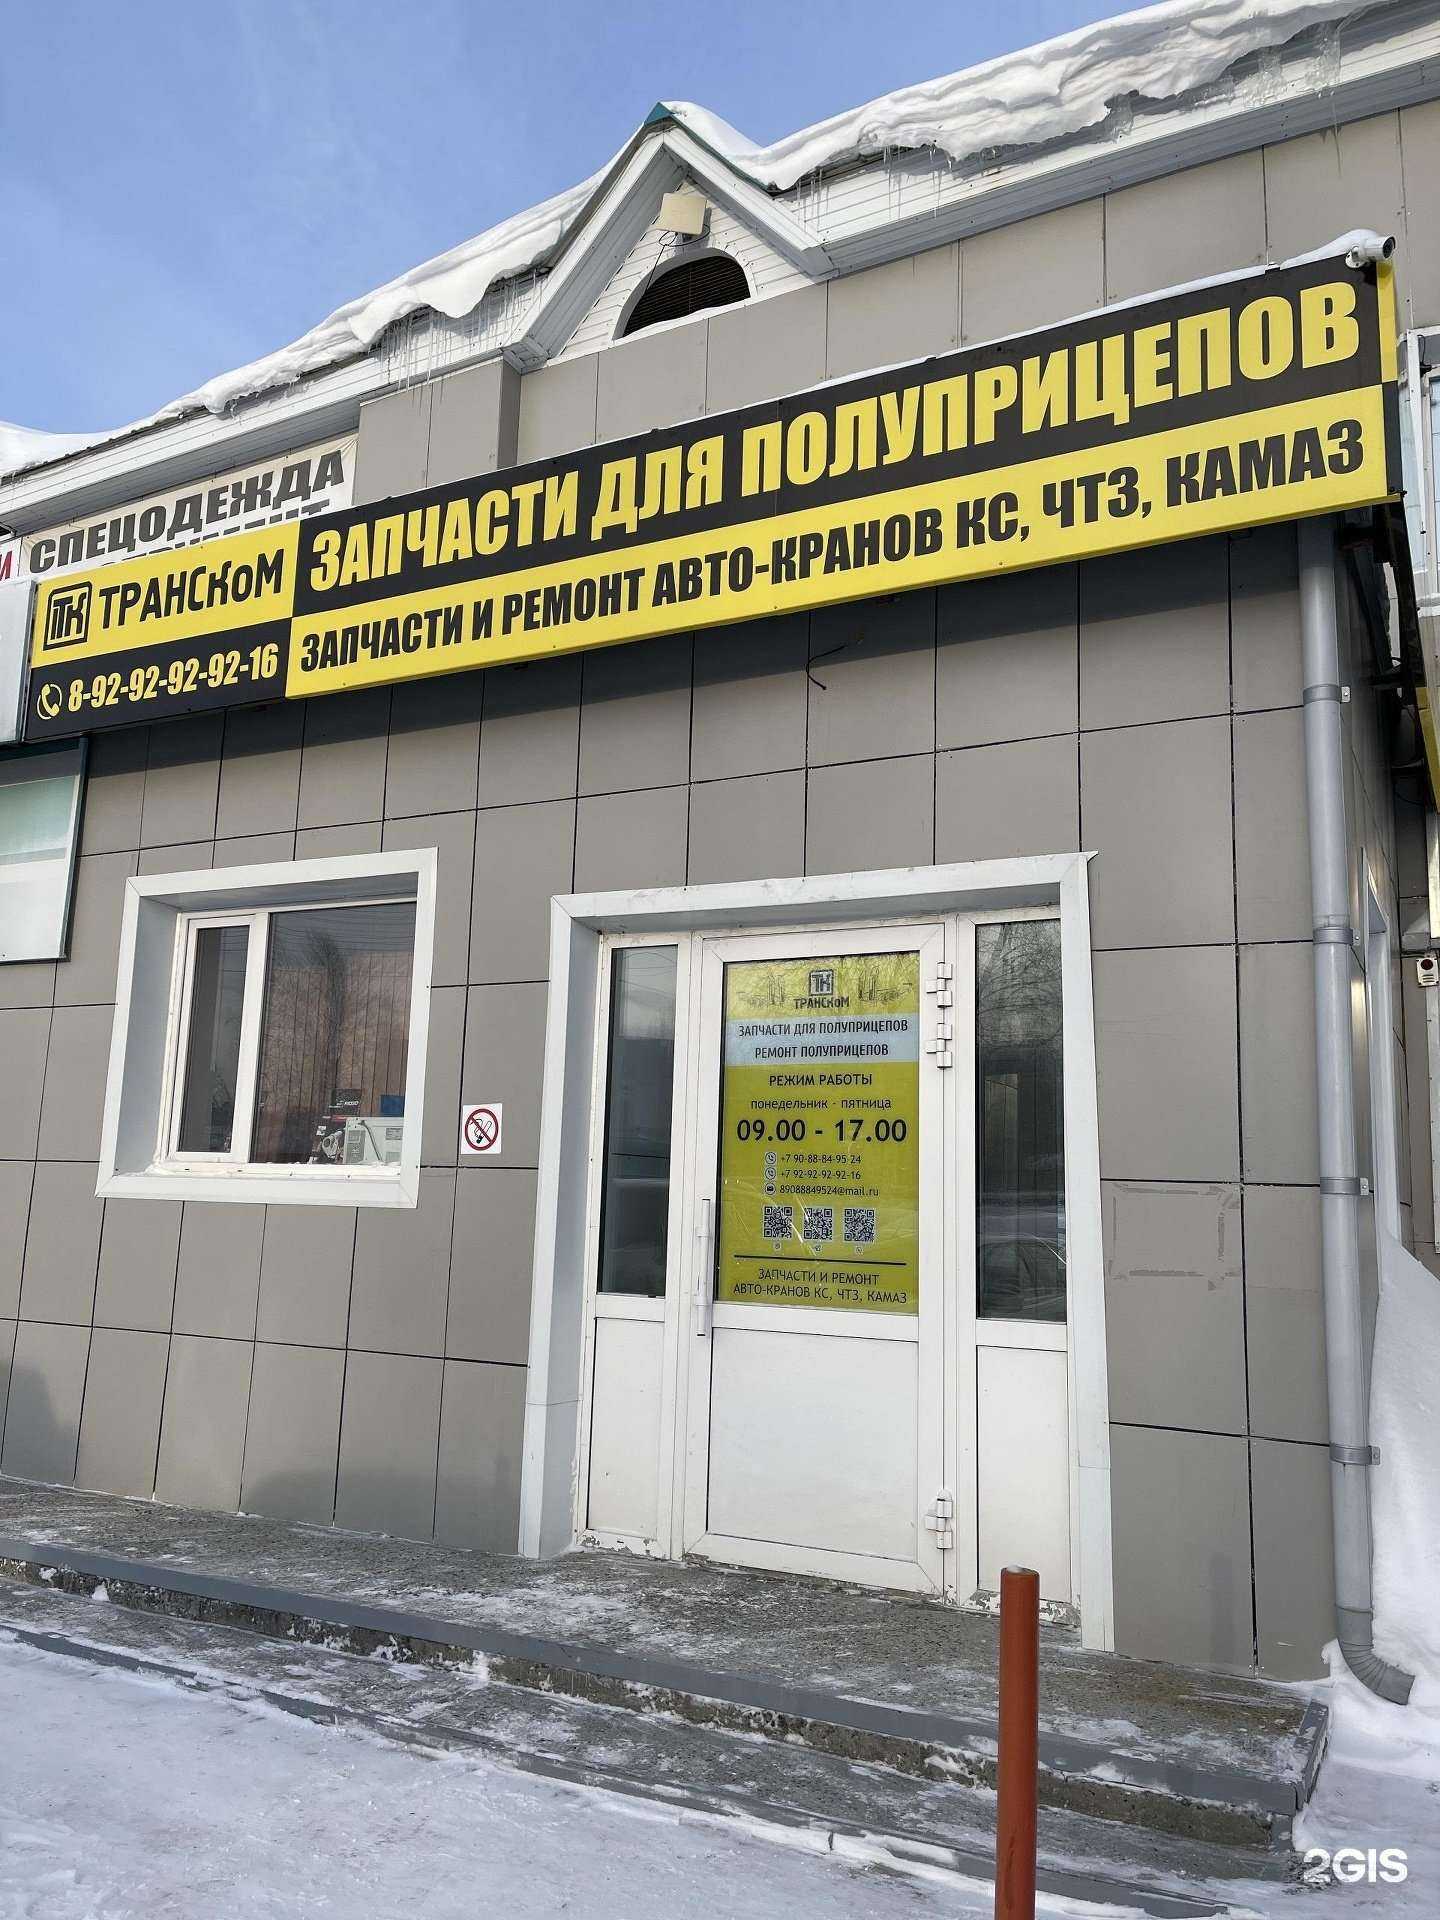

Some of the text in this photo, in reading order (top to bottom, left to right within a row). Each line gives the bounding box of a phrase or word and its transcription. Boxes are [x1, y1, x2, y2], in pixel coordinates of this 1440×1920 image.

[310, 471, 579, 592] ЗАПЧАСТИ
[591, 436, 724, 541] ДЛЯ
[741, 281, 1360, 497] ПОЛУПРИЦЕПОВ
[29, 450, 345, 574] СПЕЦОДЕЖДА
[300, 605, 462, 673] ЗАПЧАСТИ
[472, 598, 493, 640] И
[502, 568, 645, 634] РЕМОНТ
[652, 507, 943, 607] АВТО-КРАНОВ
[956, 491, 1030, 549] КС,
[1166, 419, 1364, 507] КАМАЗ
[67, 642, 278, 712] 8-92-92-92-92-16
[738, 1019, 908, 1037] ЗАПЧАСТИ ДЛЯ ПОЛУПРИЦЕПОВ
[754, 1043, 889, 1059] РЕМОНТ ПОЛУПРИЦЕПОВ
[769, 1073, 873, 1087] РЕЖИМ РАБОТЫ
[751, 1100, 828, 1111] понедельник
[841, 1099, 892, 1110] пятница
[736, 1119, 807, 1142] 09.00
[834, 1118, 908, 1143] 17.00
[758, 1268, 880, 1286] ЗАПЧАСТИ И РЕМОНТ
[733, 1283, 811, 1298] АВТО-КРАНОВ
[867, 1291, 907, 1304] КАМАЗ
